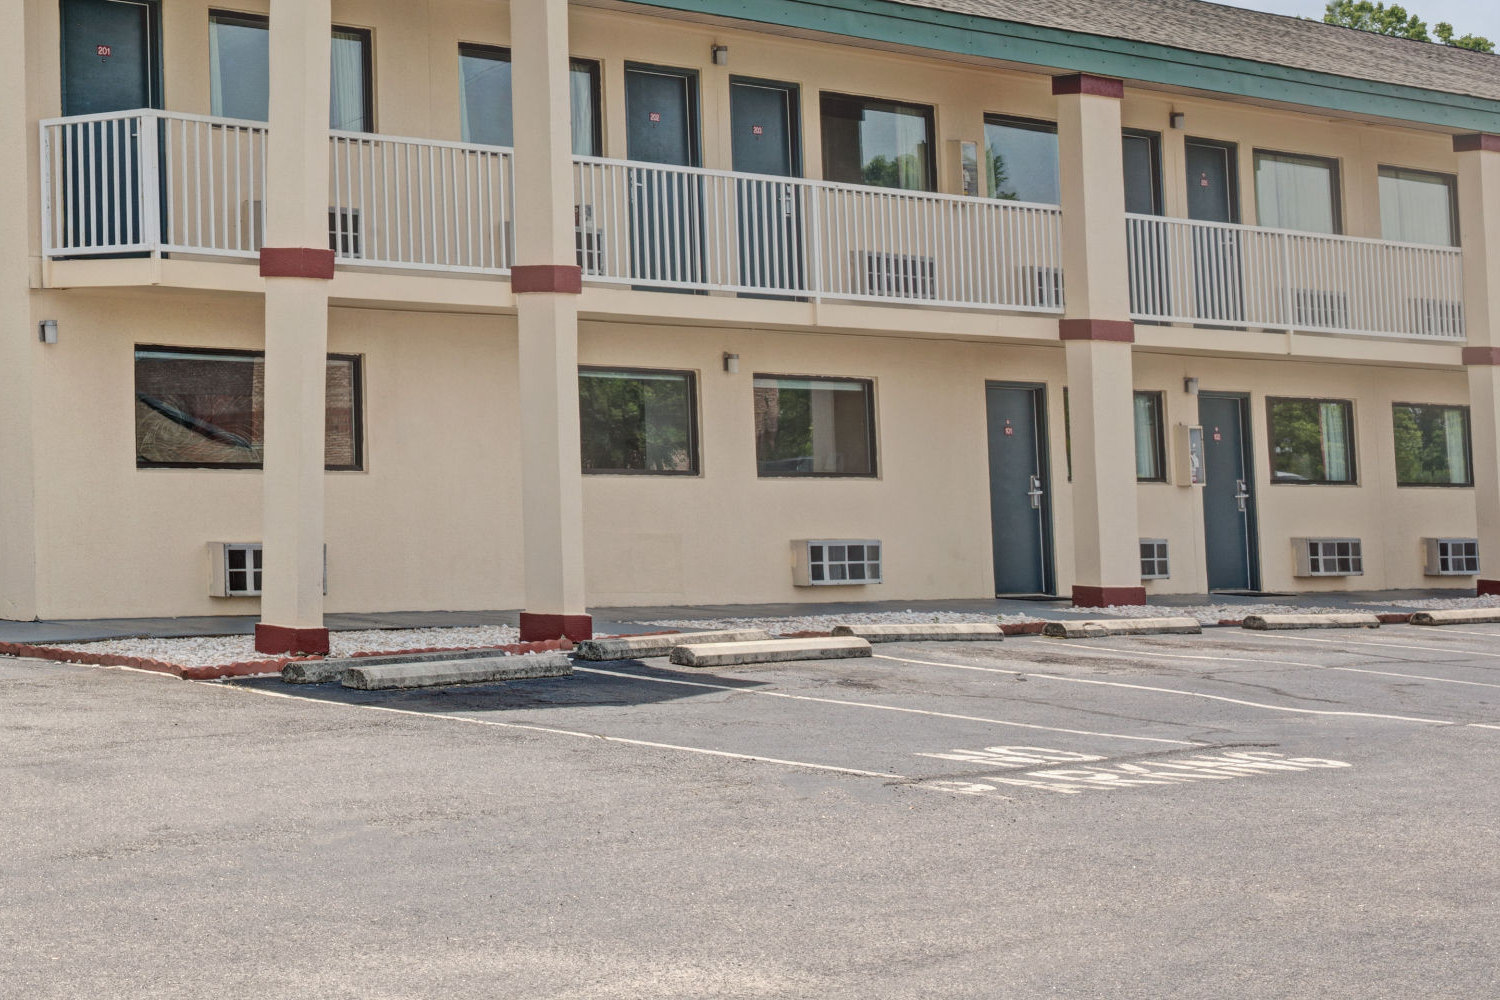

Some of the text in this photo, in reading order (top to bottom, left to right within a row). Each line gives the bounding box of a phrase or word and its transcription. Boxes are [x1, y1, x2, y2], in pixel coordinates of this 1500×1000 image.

[97, 46, 110, 55] 201
[912, 745, 1109, 768] NO
[908, 751, 1353, 799] PARKING
